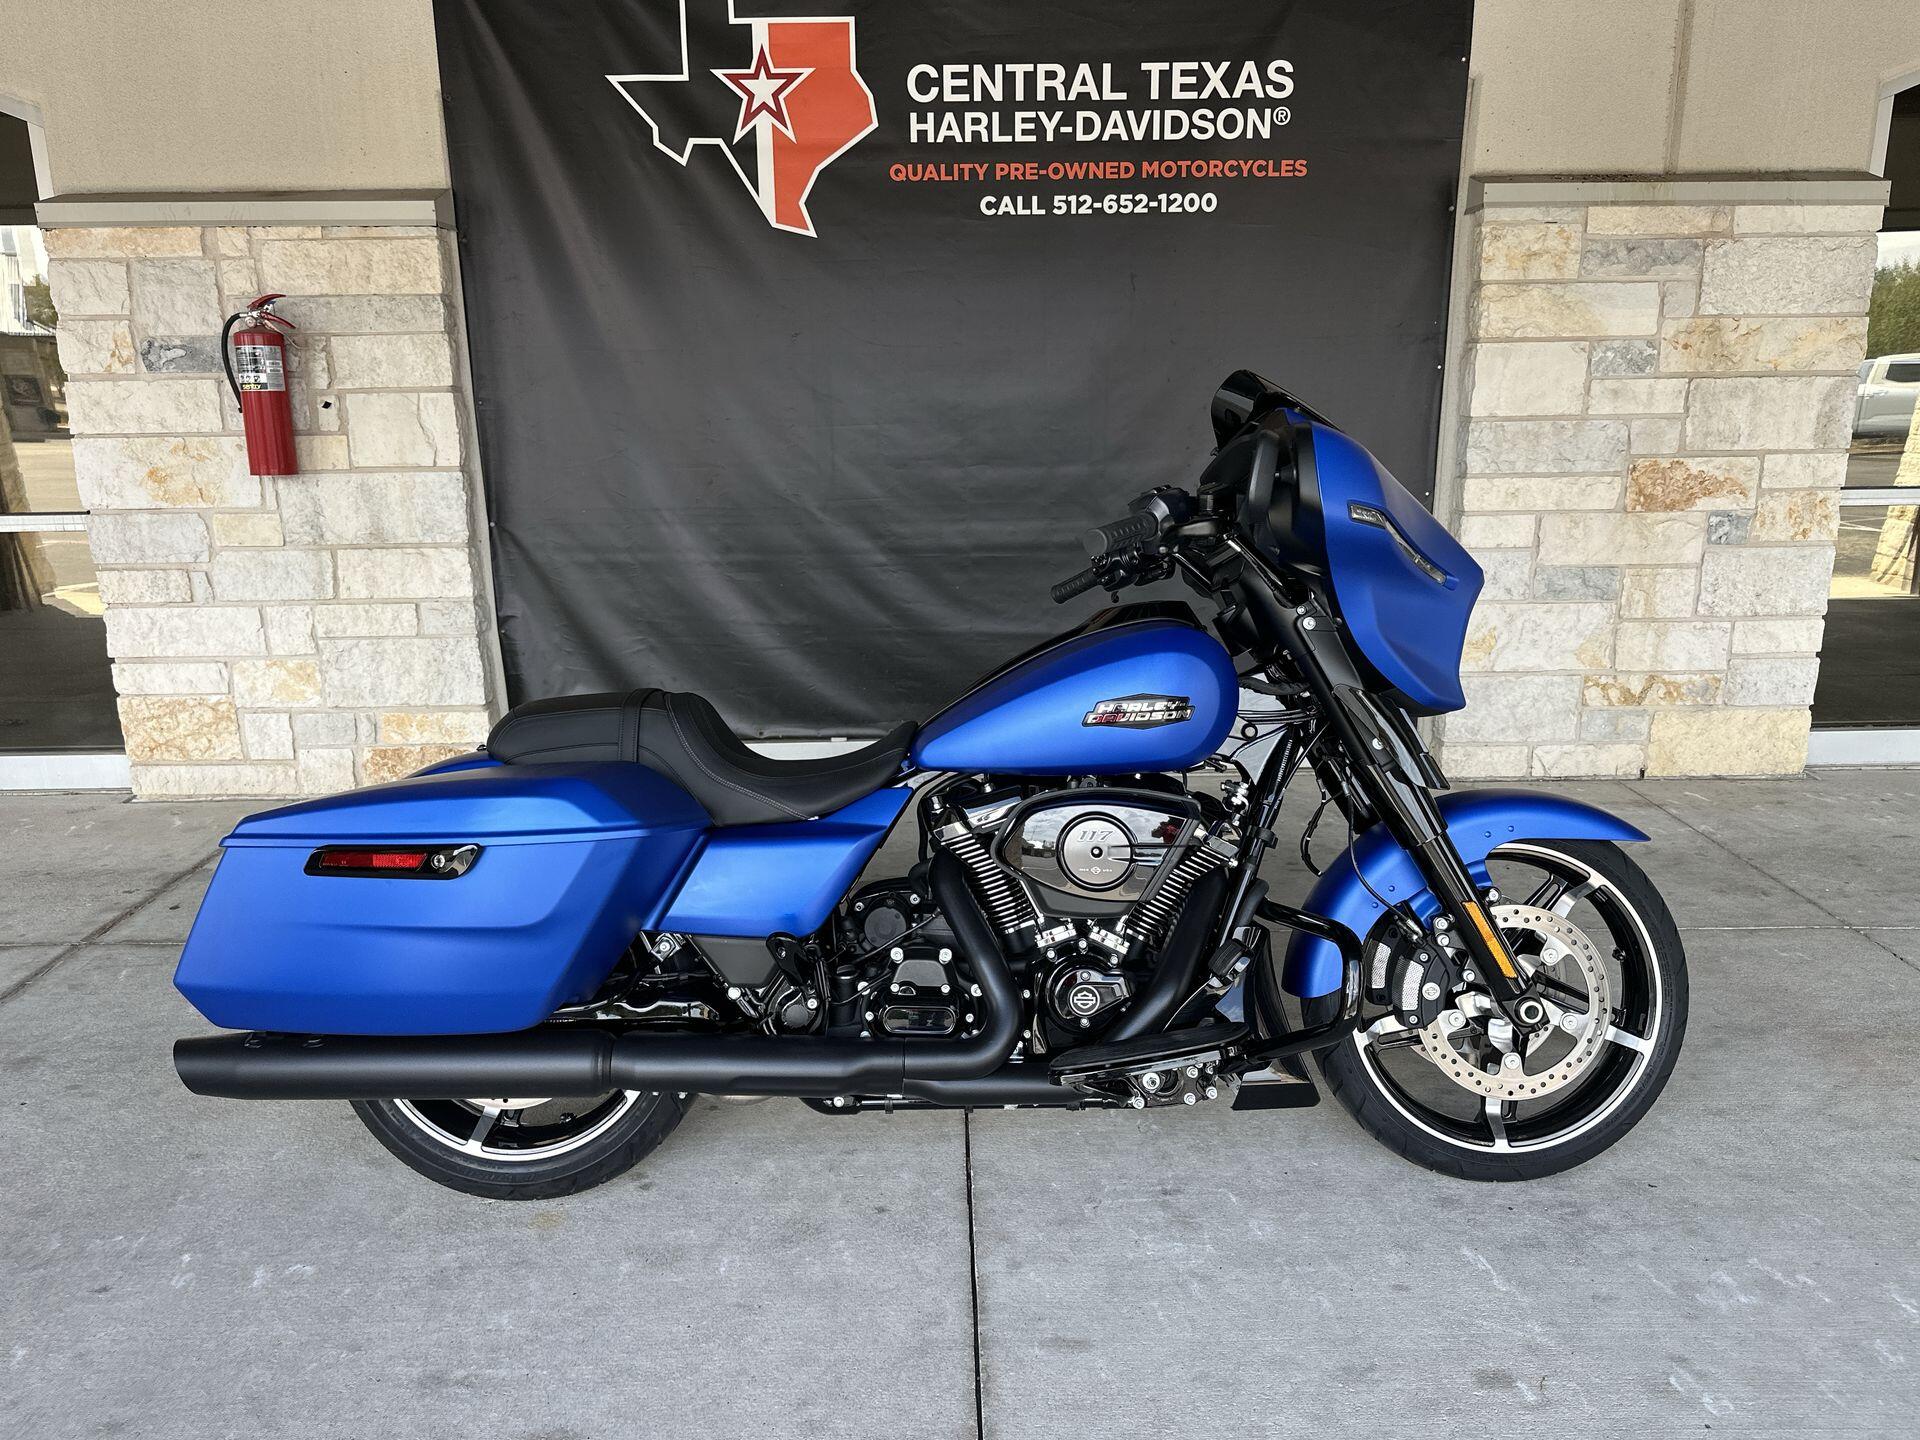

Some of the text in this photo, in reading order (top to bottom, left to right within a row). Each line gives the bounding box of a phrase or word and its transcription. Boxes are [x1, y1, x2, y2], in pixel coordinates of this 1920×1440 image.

[906, 59, 1295, 103] CENTRAL TEXAS
[889, 159, 1307, 182] QUALITY PRE-OWNED MOTORCYCLES
[979, 192, 1217, 216] CALL 512-652-1200
[1086, 709, 1192, 724] DAVIDSON
[1078, 830, 1114, 842] 117
